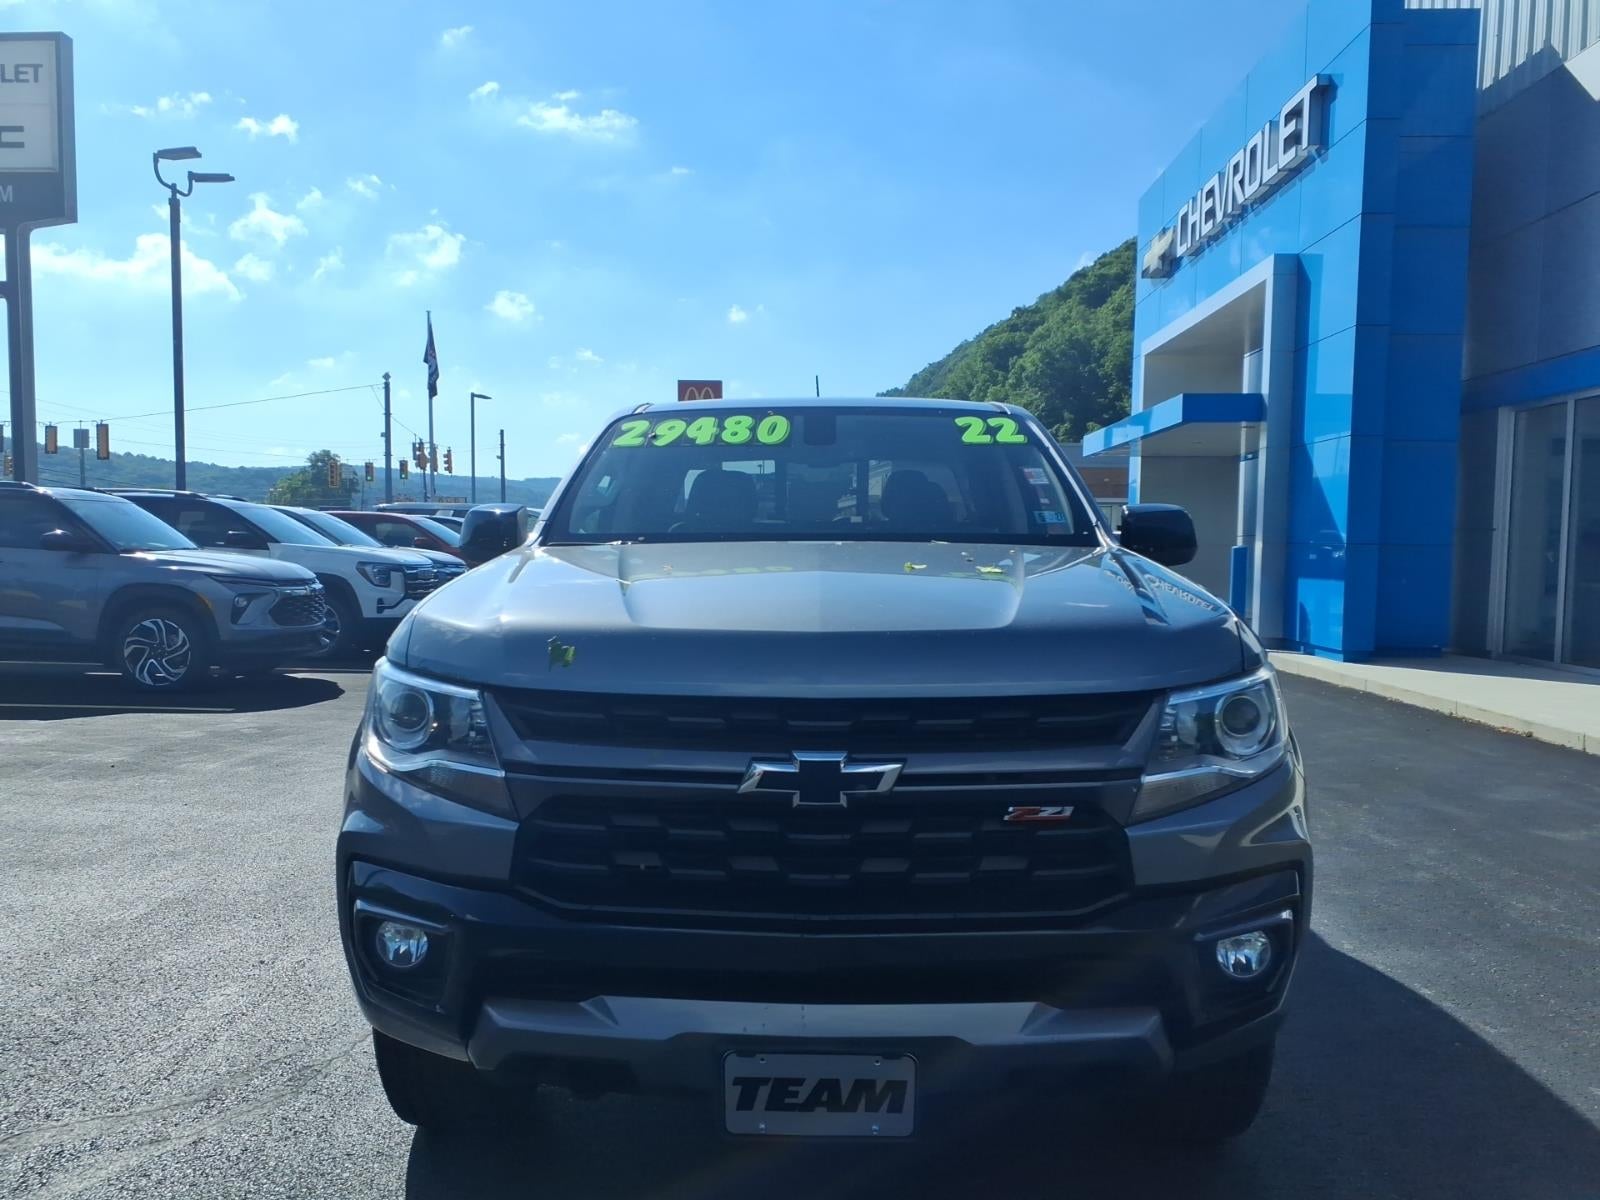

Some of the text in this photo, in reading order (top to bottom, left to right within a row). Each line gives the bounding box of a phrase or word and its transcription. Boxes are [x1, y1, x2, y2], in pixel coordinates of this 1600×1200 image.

[1177, 73, 1324, 258] CHEVROLET
[613, 415, 790, 448] 29480
[954, 416, 1028, 445] 22
[732, 1077, 908, 1114] TEAM
